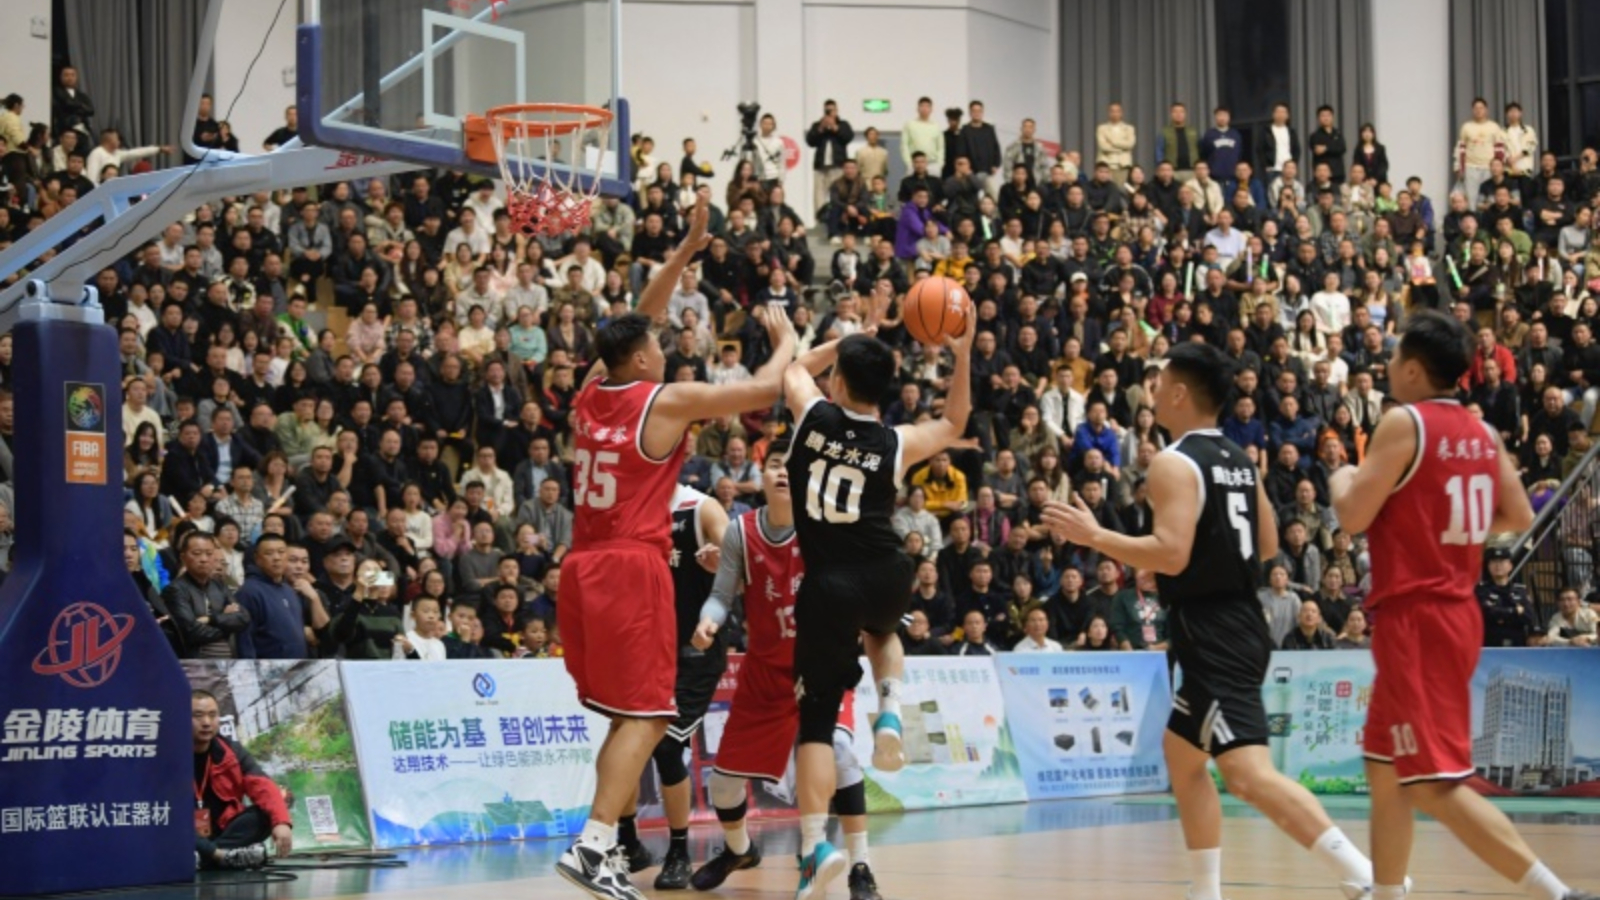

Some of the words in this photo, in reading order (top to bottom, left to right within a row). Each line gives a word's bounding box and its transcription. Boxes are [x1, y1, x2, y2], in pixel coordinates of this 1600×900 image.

[72, 440, 100, 458] FIBA
[805, 430, 882, 472] 腾龙水泥
[574, 448, 620, 511] 35
[805, 458, 866, 524] 10
[1227, 492, 1253, 560] 5
[1440, 473, 1494, 546] 10
[1, 707, 162, 744] 金陵体育
[388, 717, 487, 752] 储能为基
[499, 714, 590, 747] 智创未来
[1389, 722, 1419, 757] 10
[1, 745, 78, 762] JINLING
[83, 744, 157, 758] SPORTS
[1, 801, 171, 834] 国际篮联认证器材
